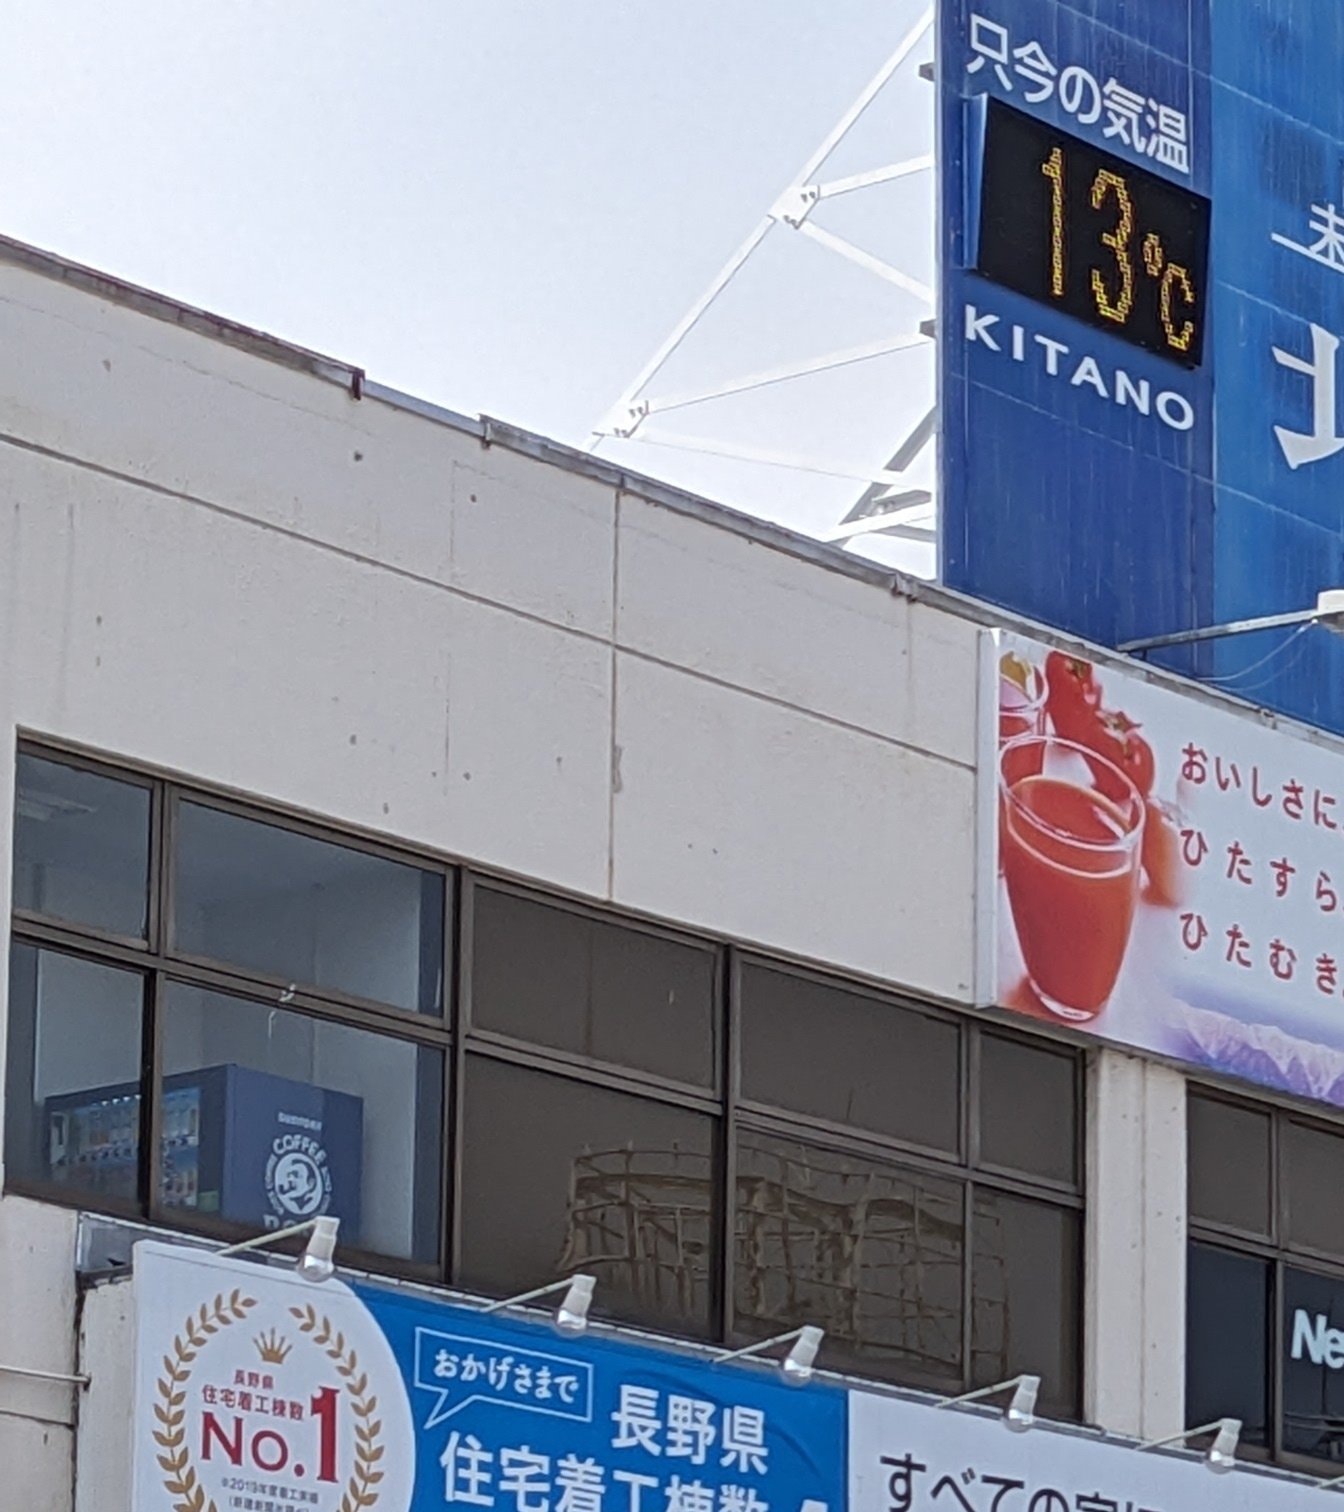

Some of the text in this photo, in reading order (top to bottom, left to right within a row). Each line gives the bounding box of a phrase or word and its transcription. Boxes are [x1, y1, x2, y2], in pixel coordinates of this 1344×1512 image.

[966, 14, 1190, 174] 只今の気温
[964, 306, 1194, 430] KITANO
[273, 1133, 327, 1166] COFFEE
[202, 1384, 304, 1422] 住宅着工棟数
[233, 1370, 274, 1390] 長野県
[432, 1347, 580, 1405] おかげさまで
[201, 1386, 340, 1483] No.1
[610, 1383, 769, 1476] 長野県
